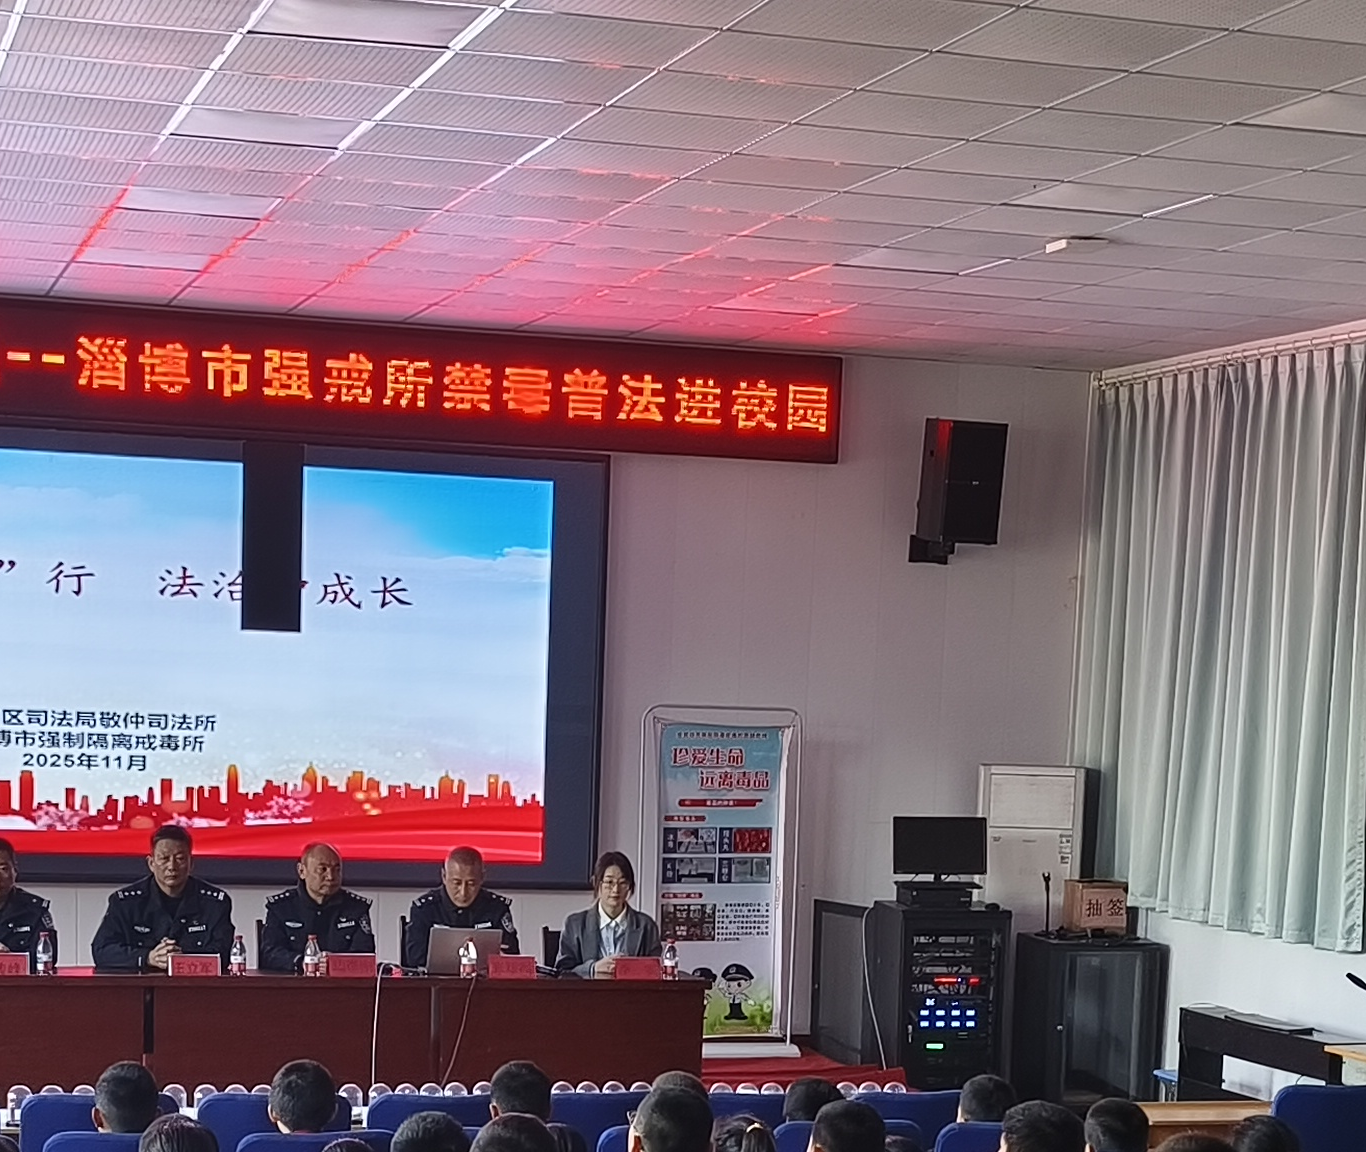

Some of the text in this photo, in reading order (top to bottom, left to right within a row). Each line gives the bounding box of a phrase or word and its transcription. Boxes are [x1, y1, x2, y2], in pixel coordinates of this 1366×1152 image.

[158, 566, 414, 610] 法治成长
[22, 753, 147, 772] 2025年11月
[672, 746, 744, 766] 珍爱生命
[699, 769, 770, 790] 远离毒品
[1086, 899, 1124, 917] 抽签
